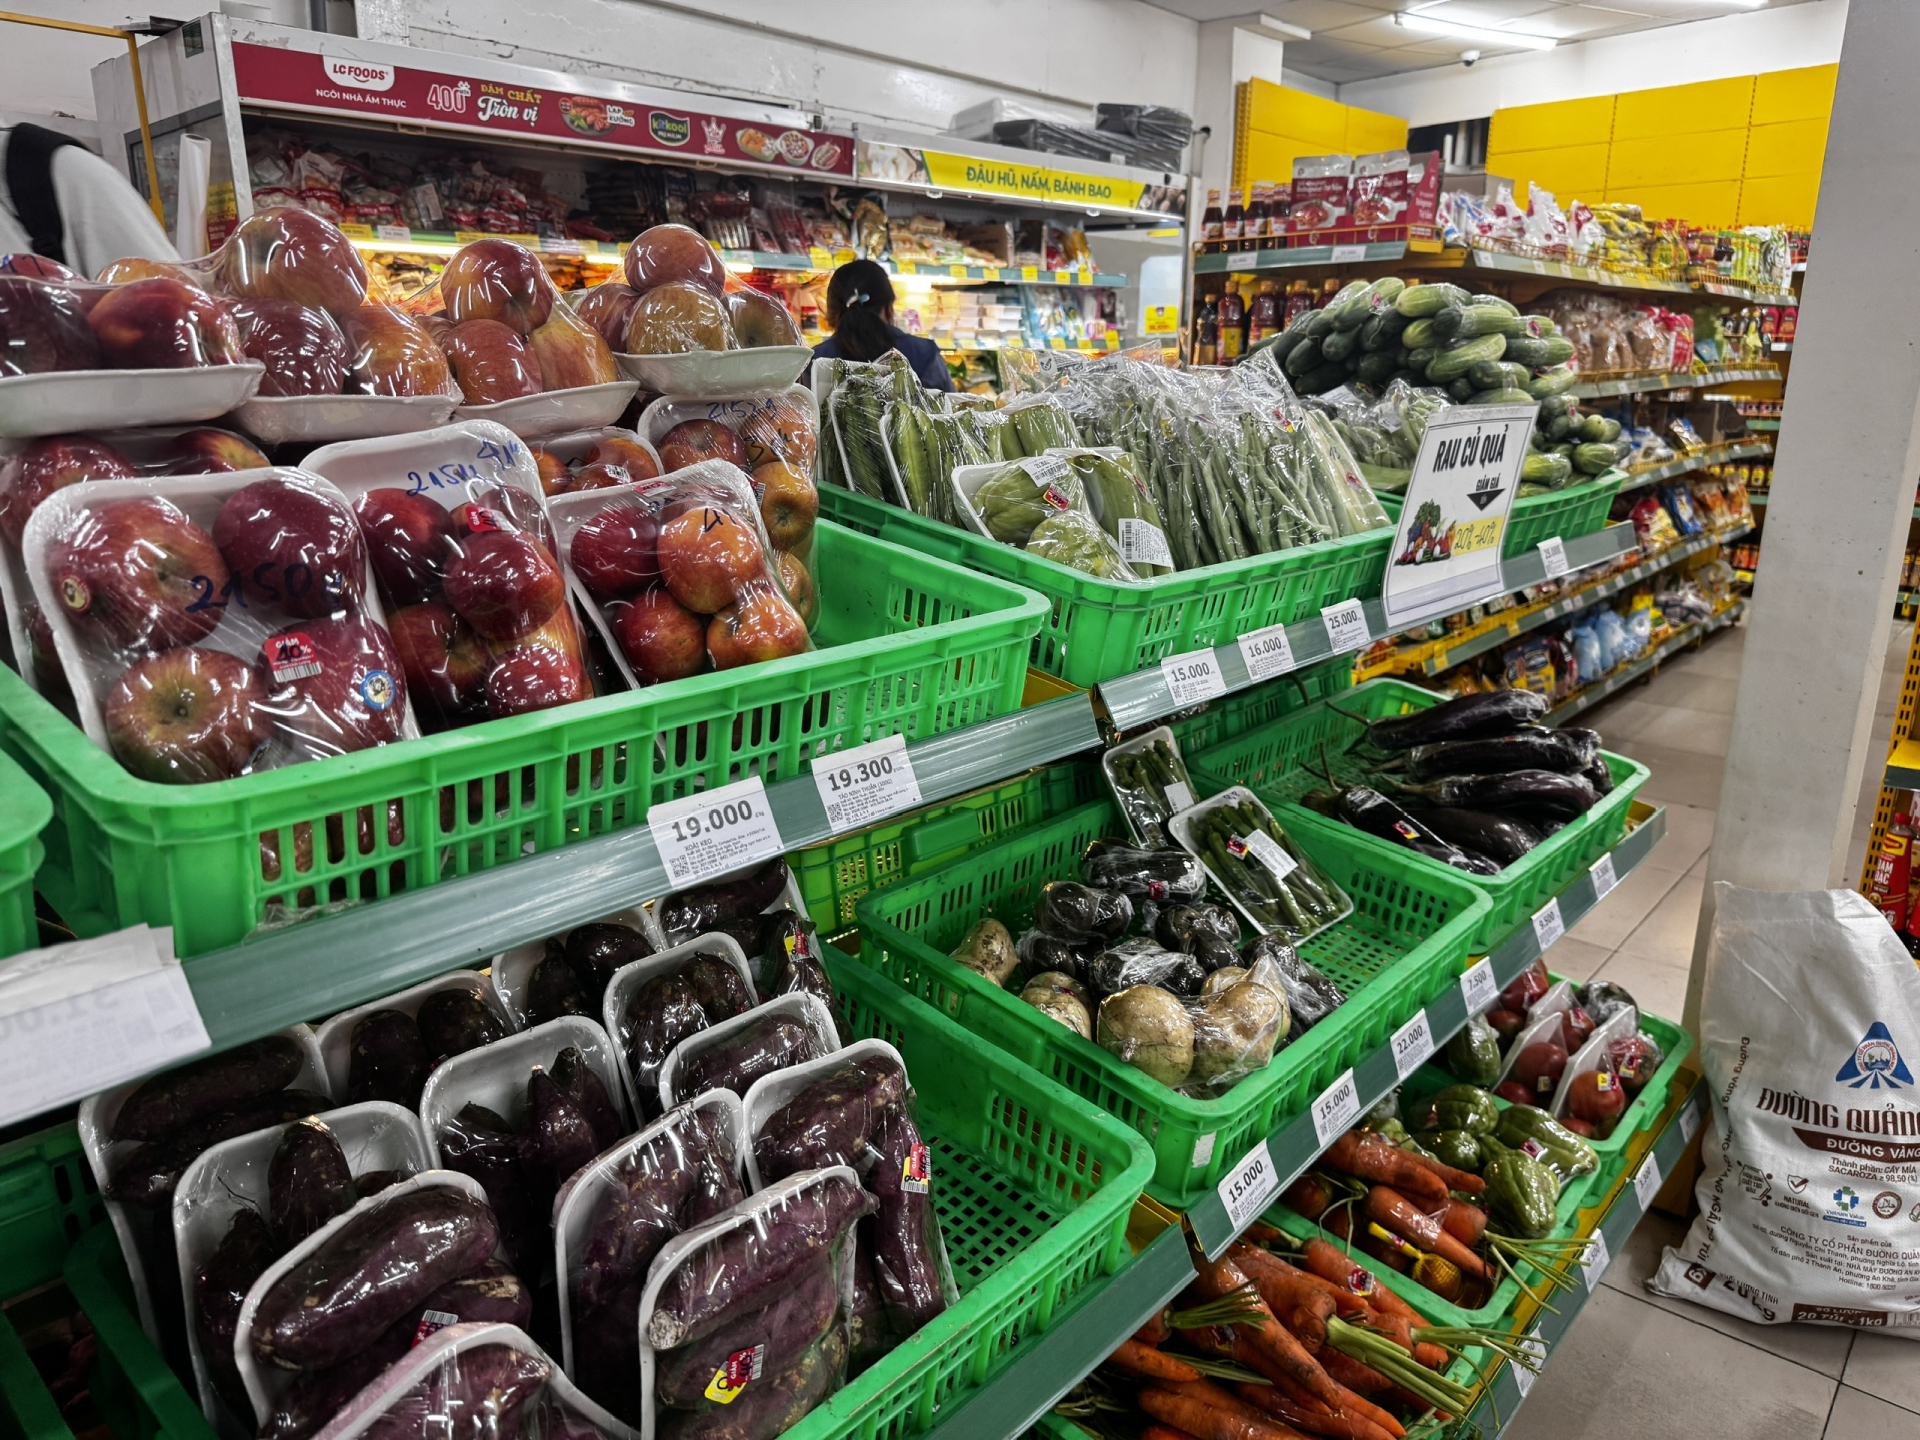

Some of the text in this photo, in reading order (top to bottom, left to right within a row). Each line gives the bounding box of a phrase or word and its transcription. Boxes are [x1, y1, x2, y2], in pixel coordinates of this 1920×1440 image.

[333, 63, 385, 80] LC FOODS
[316, 89, 340, 99] NGÔI
[342, 92, 364, 102] NHÀ
[382, 98, 406, 109] THỰC
[427, 84, 466, 113] 400
[507, 89, 542, 104] CHẤT
[477, 96, 538, 127] Tròn vị
[966, 164, 1112, 199] ĐẬU HŨ, NẤM, BÁNH BAO
[1433, 424, 1509, 472] RAU CỦ QUẢ
[1329, 610, 1357, 629] 25.000
[1249, 637, 1282, 657] 16.000
[1171, 662, 1210, 682] 15.000
[827, 756, 893, 791] 19.300
[672, 800, 752, 843] 19.000
[1397, 1025, 1423, 1054] 22.000
[1320, 1084, 1350, 1120] 15.000
[1756, 1088, 1920, 1136] ĐƯỜNG QUẢN
[1827, 1138, 1884, 1158] ĐƯỜNG
[1828, 1165, 1877, 1181] SACAROZA
[1885, 1175, 1906, 1183] 98,50
[1831, 1157, 1858, 1169] Thành
[1902, 1164, 1917, 1174] MÍA
[1229, 1160, 1263, 1203] 15.000
[1783, 1195, 1811, 1209] NATURAL
[1780, 1226, 1805, 1241] CÔNG
[1808, 1235, 1819, 1244] TY
[1822, 1237, 1836, 1249] CỔ
